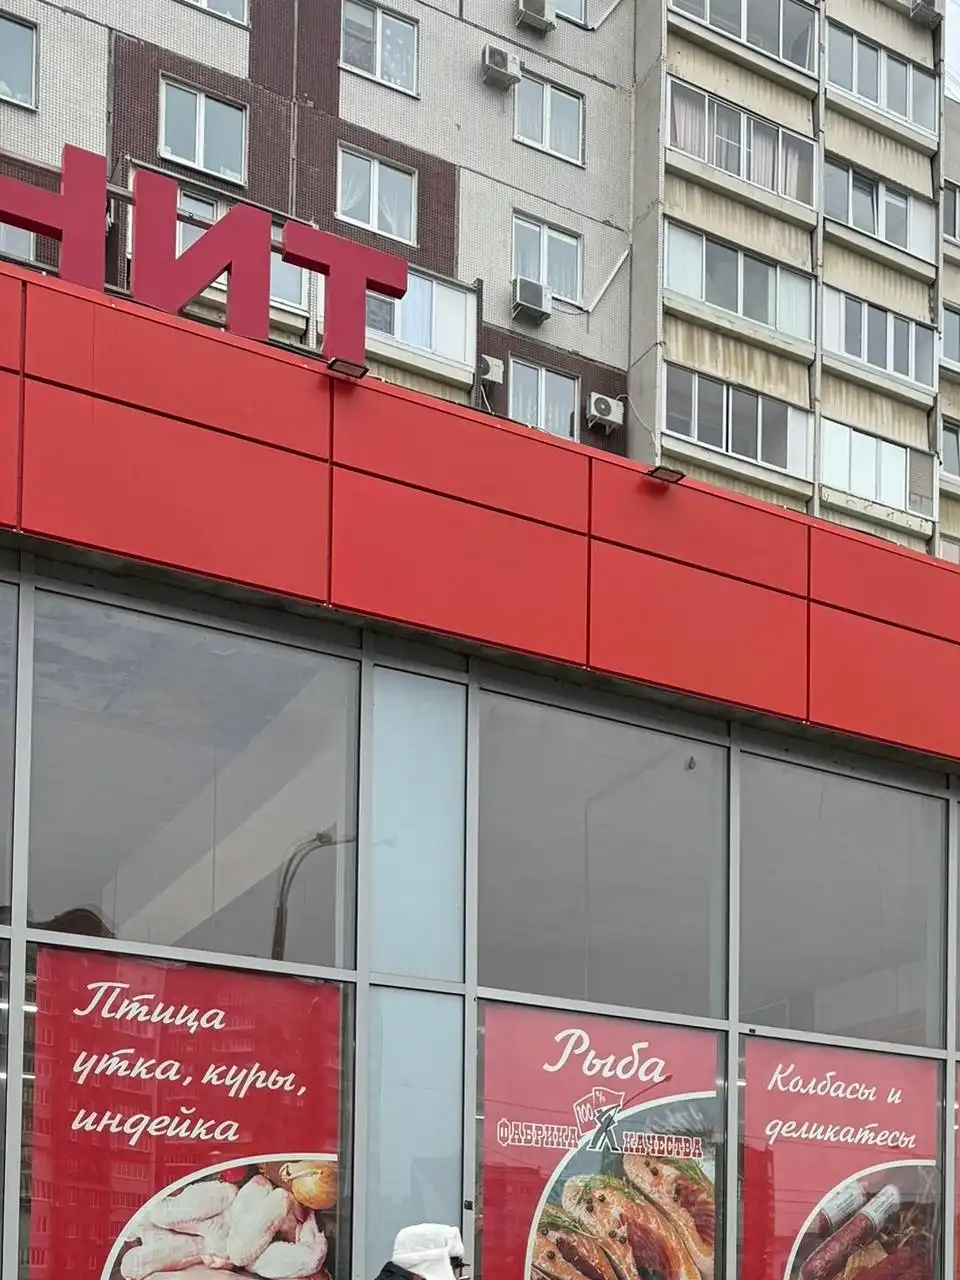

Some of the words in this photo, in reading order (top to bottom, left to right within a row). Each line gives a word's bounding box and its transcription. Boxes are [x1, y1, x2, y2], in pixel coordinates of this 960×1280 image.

[73, 981, 227, 1034] Птица
[72, 1048, 193, 1088] утка,
[201, 1060, 310, 1098] куры,
[543, 1028, 667, 1083] Рыба
[767, 1063, 877, 1101] Колбасы
[886, 1086, 903, 1104] и
[71, 1106, 240, 1146] индейка
[497, 1118, 579, 1149] ФАБРИКА
[623, 1132, 703, 1158] КАЧЕСТВА
[765, 1118, 917, 1149] деликатесы
